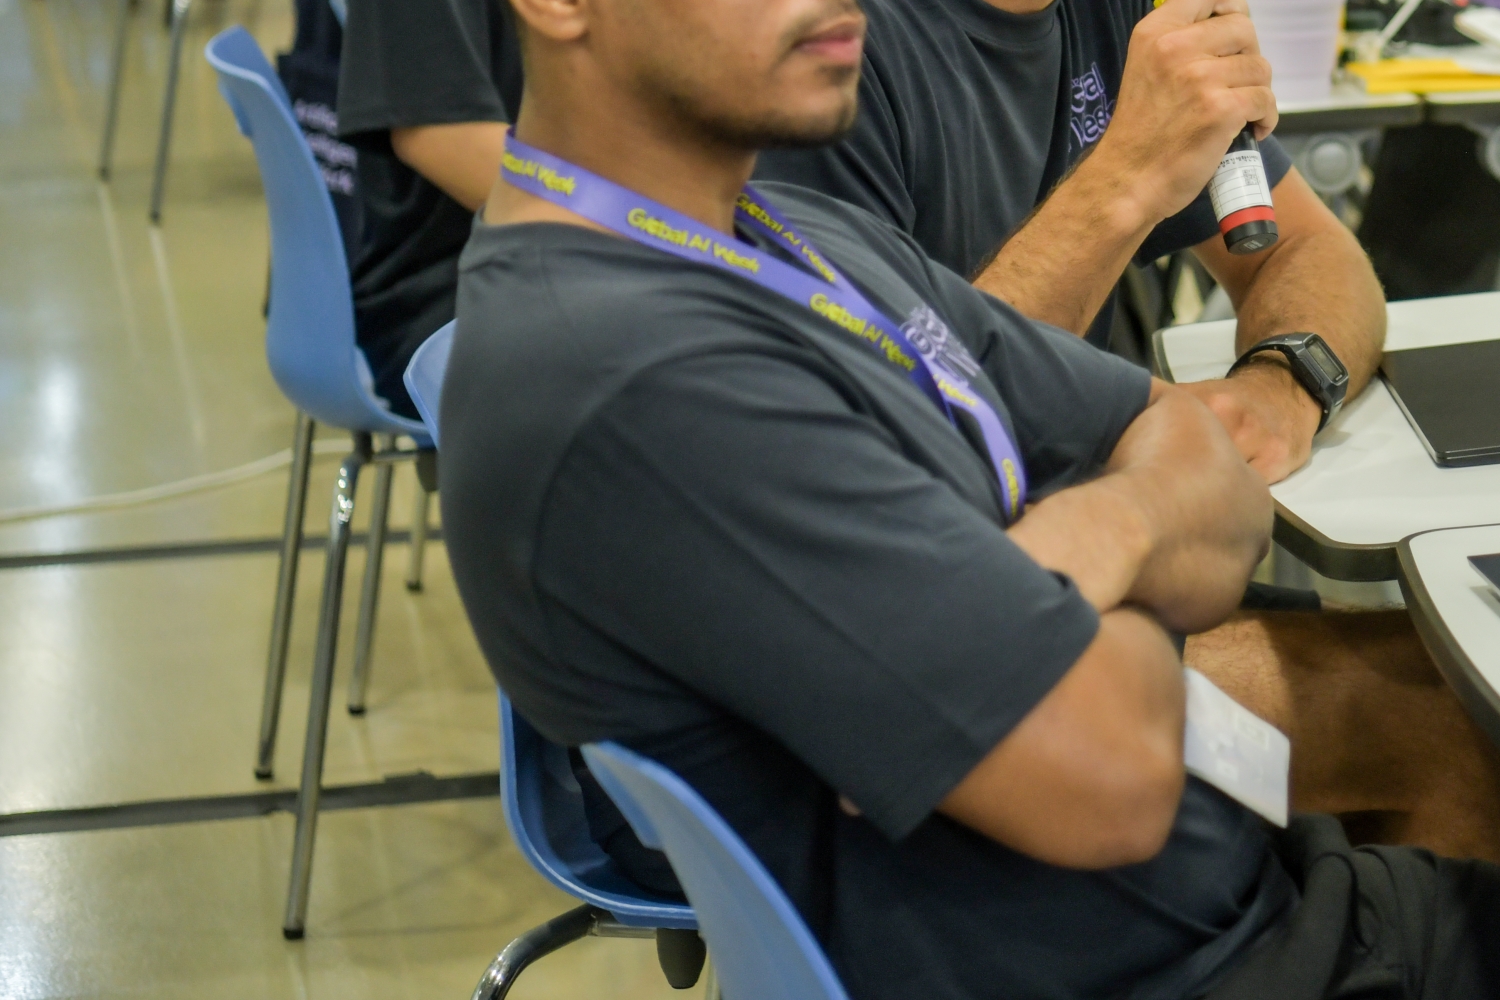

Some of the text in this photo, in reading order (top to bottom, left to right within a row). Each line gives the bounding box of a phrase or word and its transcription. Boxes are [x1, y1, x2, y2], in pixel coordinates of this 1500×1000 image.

[627, 207, 761, 275] Global AI Week
[809, 292, 867, 337] Global
[863, 324, 883, 344] AI
[879, 333, 917, 372] Week
